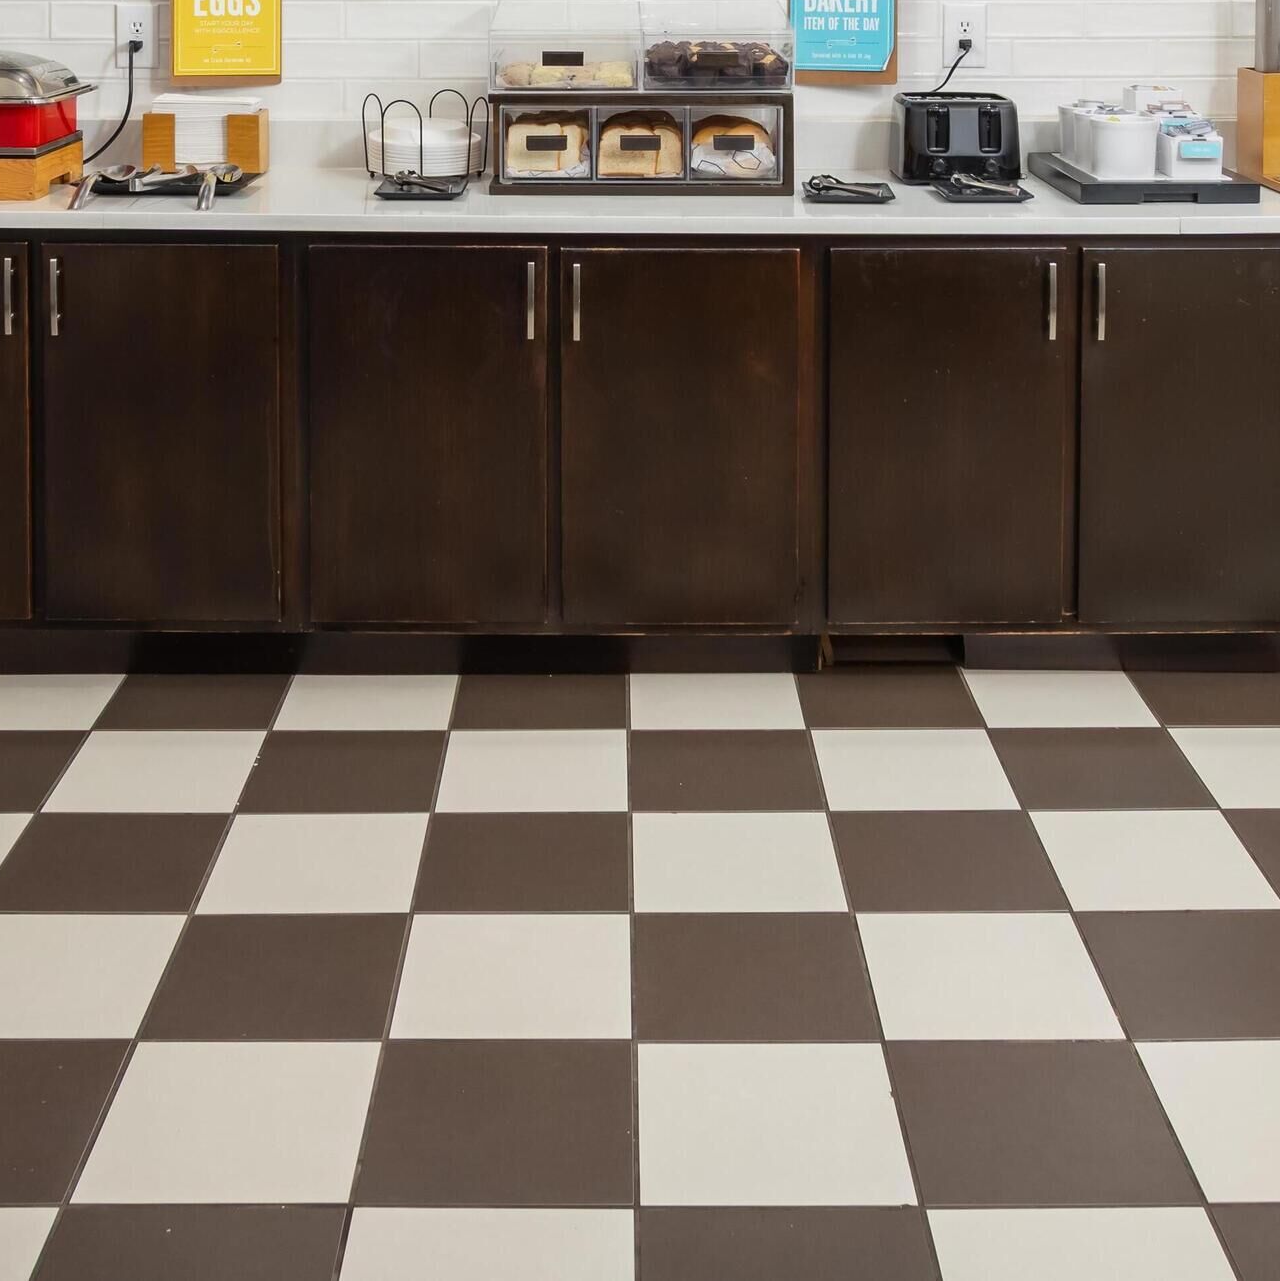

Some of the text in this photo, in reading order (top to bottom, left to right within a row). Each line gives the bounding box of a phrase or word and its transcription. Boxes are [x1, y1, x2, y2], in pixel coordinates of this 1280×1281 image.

[804, 17, 880, 31] ITEM OF THE DAY
